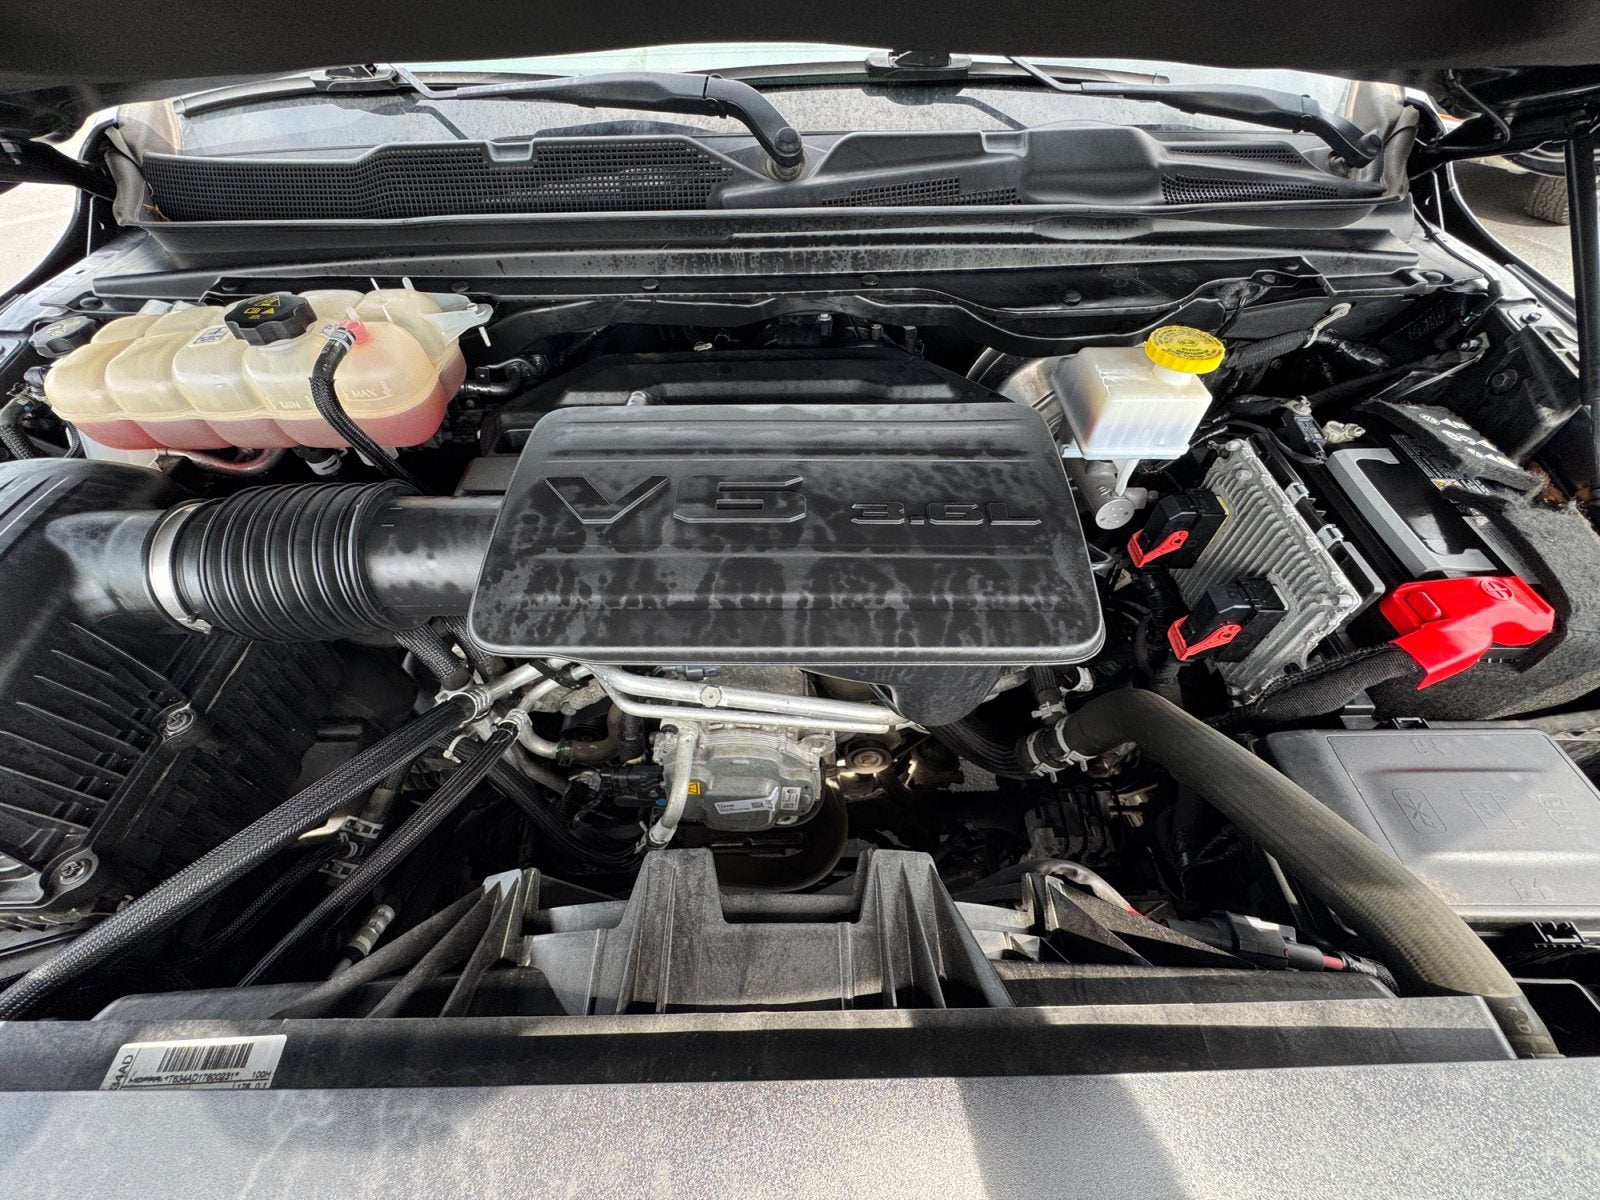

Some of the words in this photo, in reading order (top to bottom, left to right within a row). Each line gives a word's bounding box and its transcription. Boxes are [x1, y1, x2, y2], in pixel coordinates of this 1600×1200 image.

[351, 388, 378, 398] MAX
[280, 400, 302, 409] MIN
[545, 474, 807, 525] V6
[850, 502, 1042, 526] 3.6L
